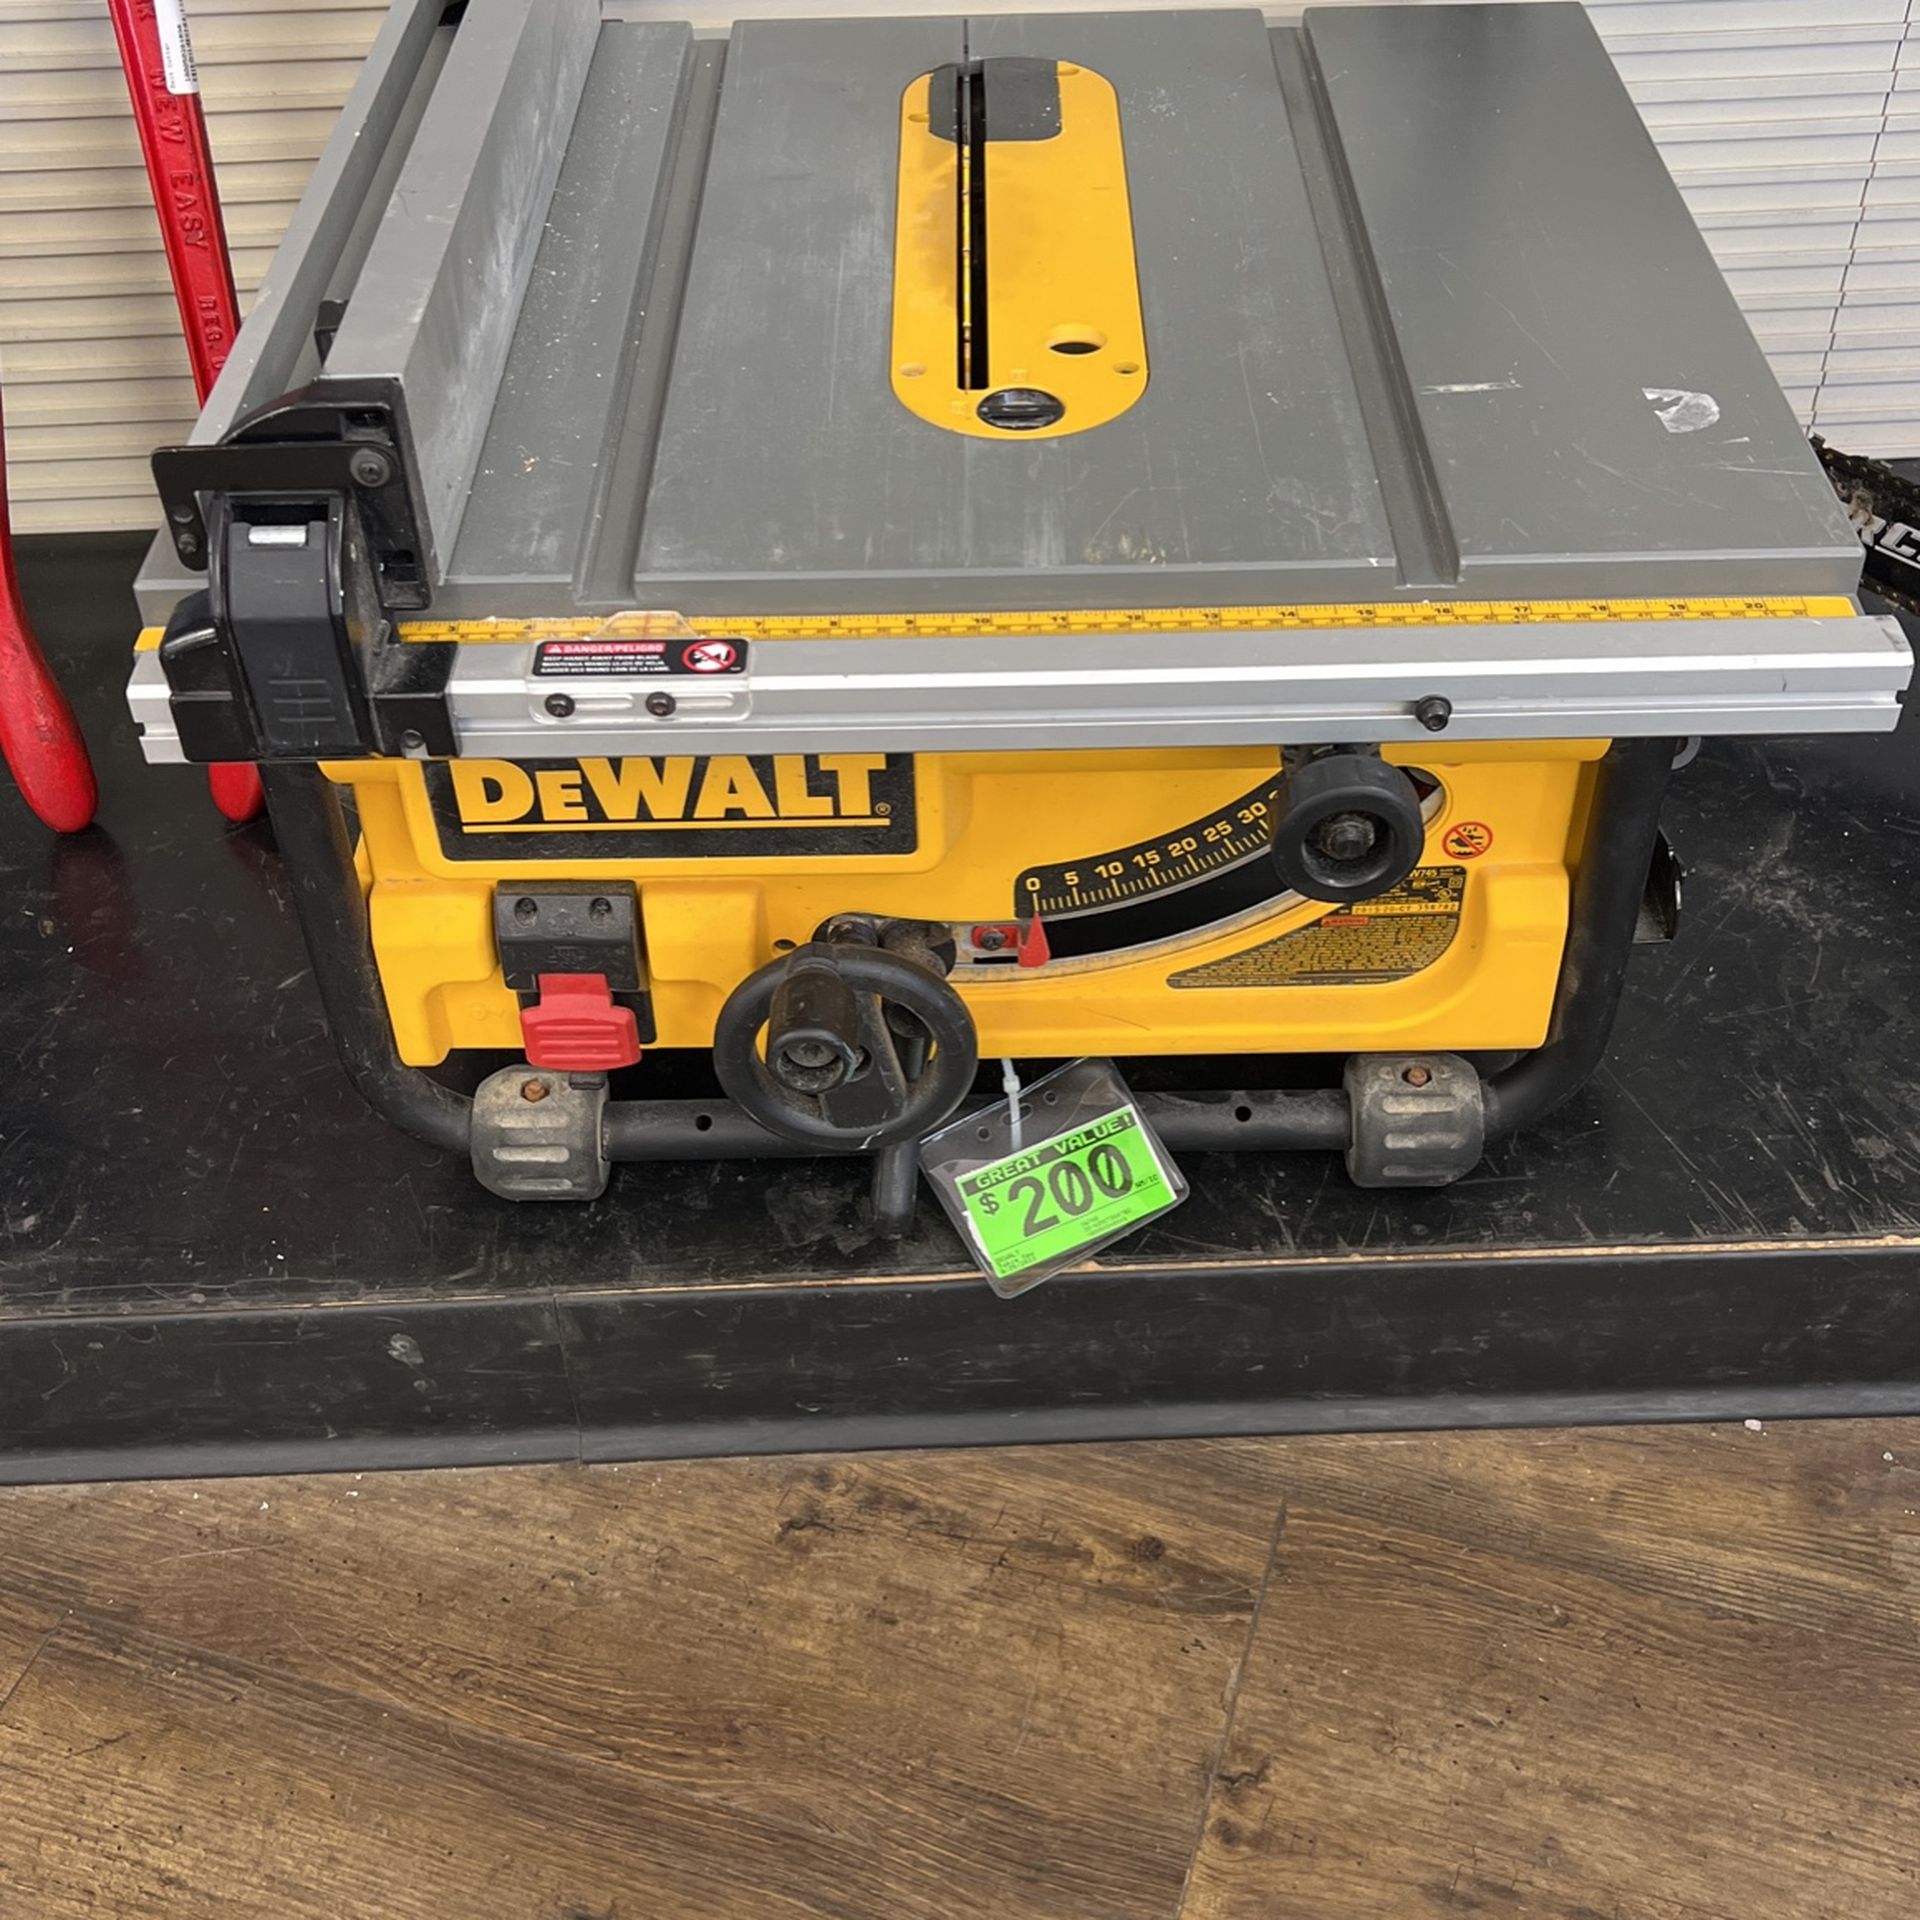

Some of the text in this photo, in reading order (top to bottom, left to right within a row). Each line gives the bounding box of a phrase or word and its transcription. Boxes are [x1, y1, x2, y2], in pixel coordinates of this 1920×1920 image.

[170, 170, 208, 249] EASY
[1744, 602, 1764, 610] 20
[449, 753, 886, 823] DEWALT
[1025, 801, 1267, 892] 0 5 10 15 20 25 30
[1408, 868, 1438, 878] W745
[977, 1114, 1133, 1189] GREAT VALUE!
